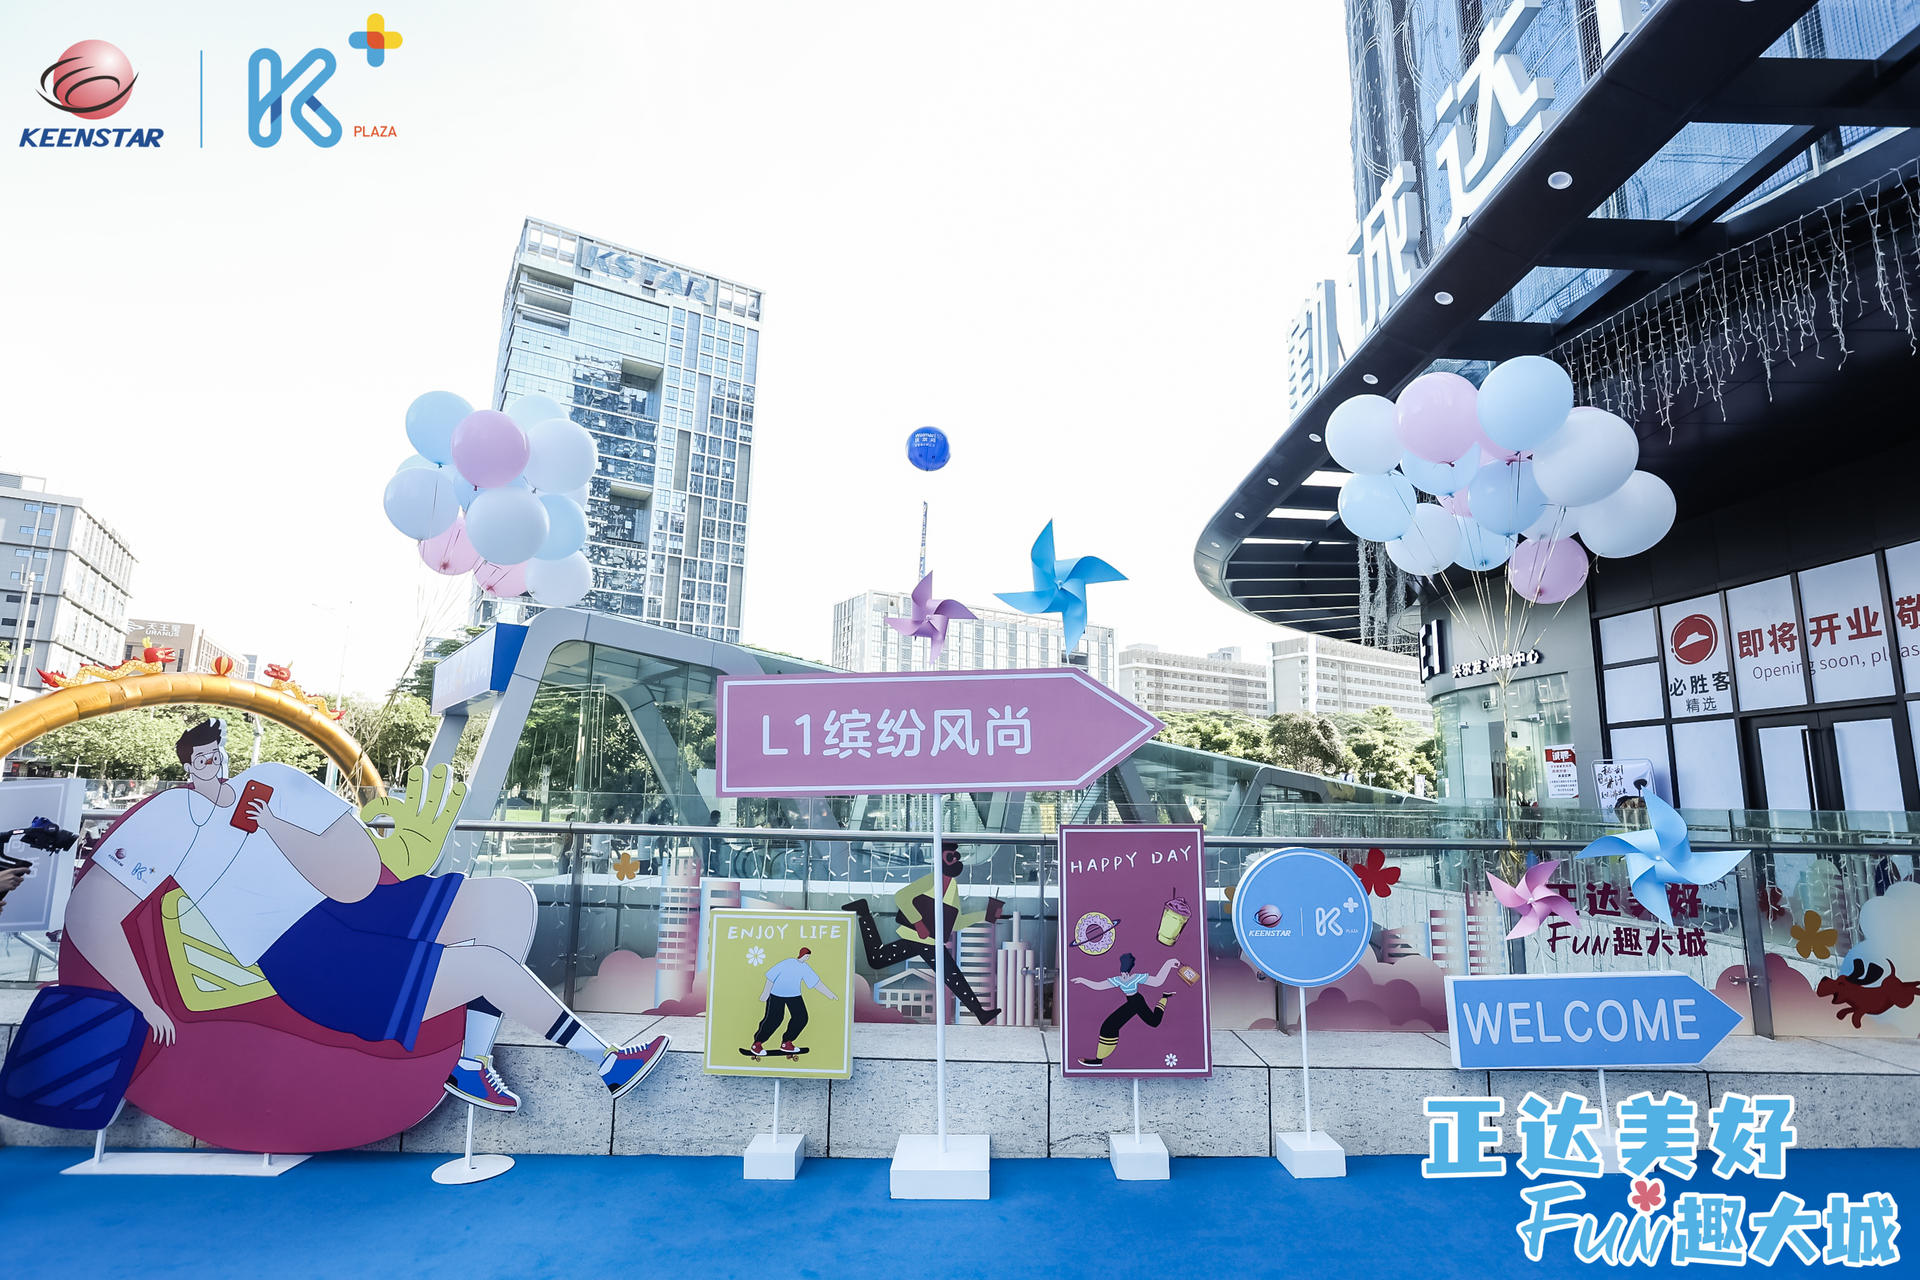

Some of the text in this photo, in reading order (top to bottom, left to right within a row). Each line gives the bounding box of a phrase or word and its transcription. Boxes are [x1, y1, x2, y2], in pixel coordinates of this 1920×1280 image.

[1286, 0, 1650, 422] 勤诚达
[583, 244, 711, 303] KSTAR
[1820, 653, 1866, 670] soon,
[1871, 644, 1920, 667] plas
[1669, 671, 1731, 697] 必胜客
[1685, 696, 1718, 713] 精选
[762, 695, 1032, 759] L1缤纷风尚
[1070, 845, 1192, 874] HAPPY DAY
[727, 923, 841, 940] ENJOY LIFE
[1248, 929, 1292, 938] KEENSTAR
[1462, 998, 1701, 1046] WELCOME
